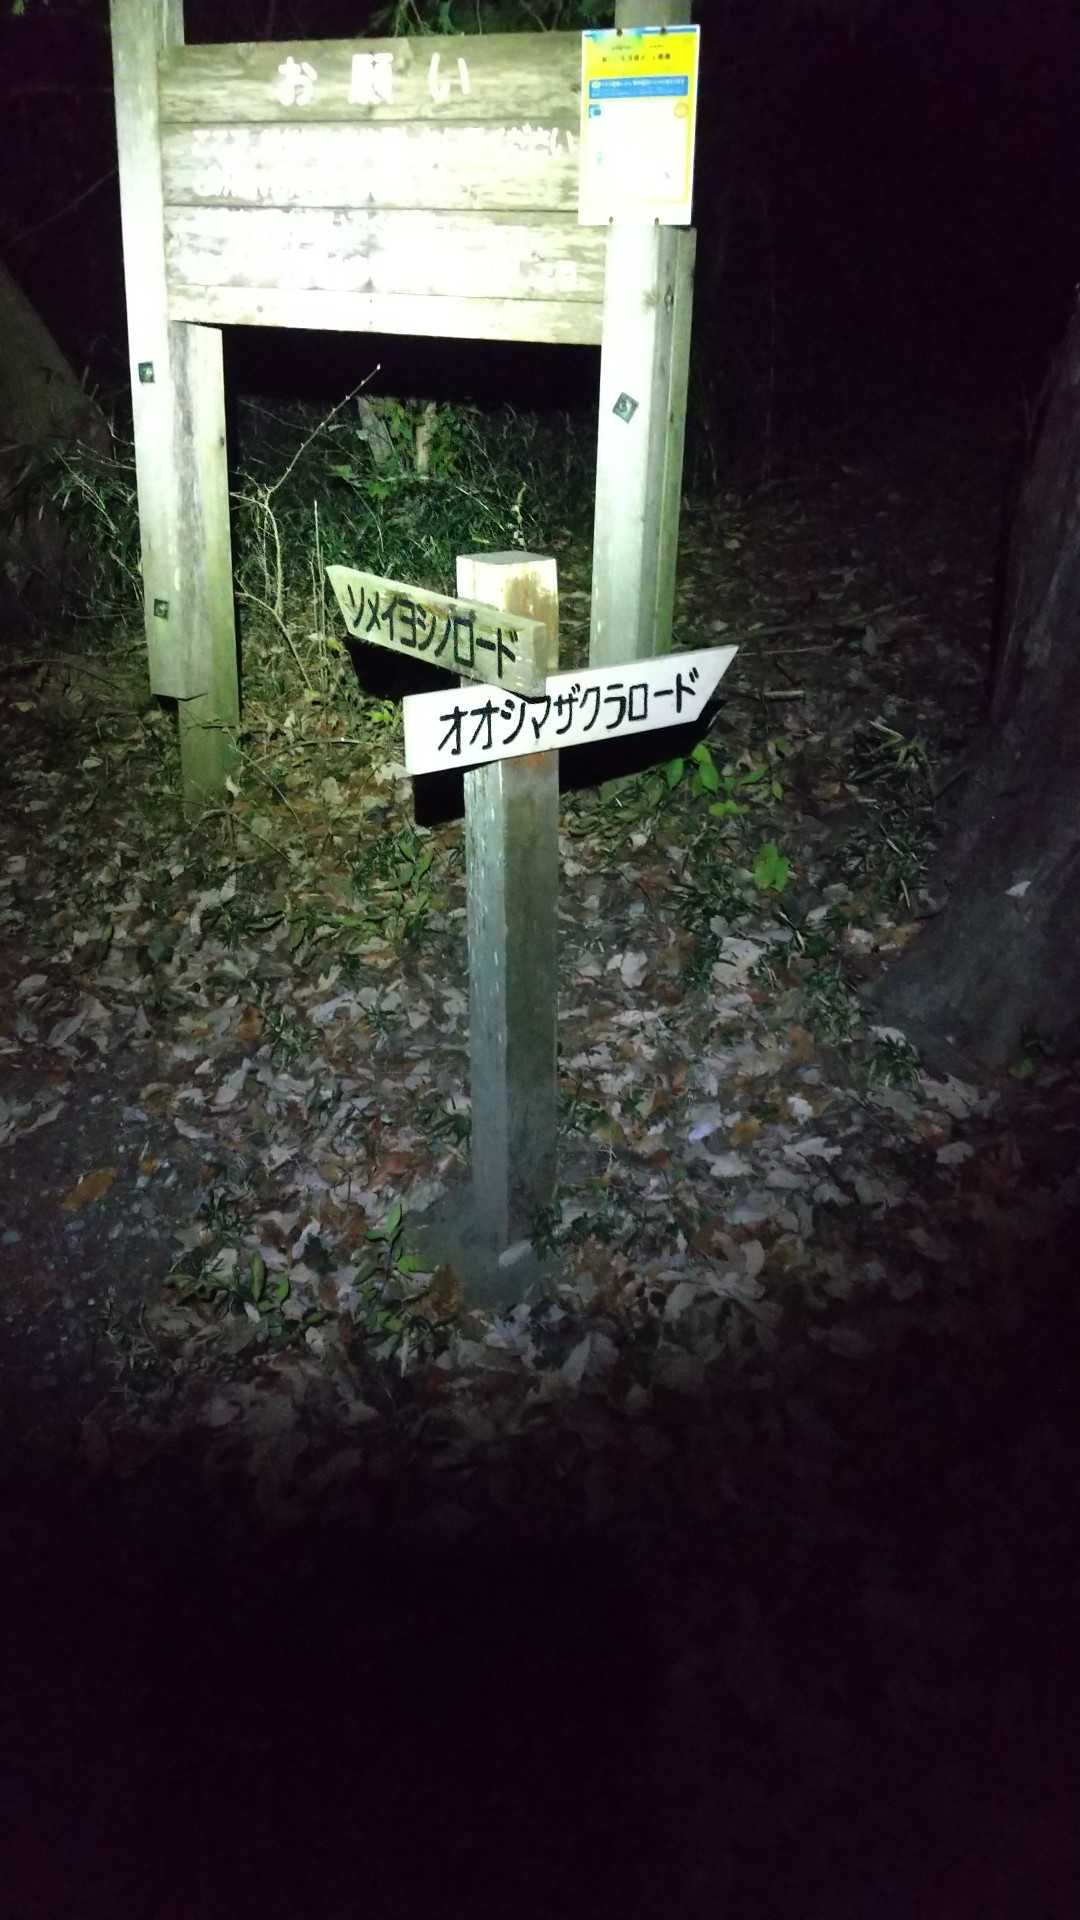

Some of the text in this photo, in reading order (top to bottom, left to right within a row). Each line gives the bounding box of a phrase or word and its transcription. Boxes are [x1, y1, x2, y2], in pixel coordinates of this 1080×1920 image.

[347, 584, 519, 679] ソメイヨシノロード
[438, 667, 700, 756] オオシマザクラロード
